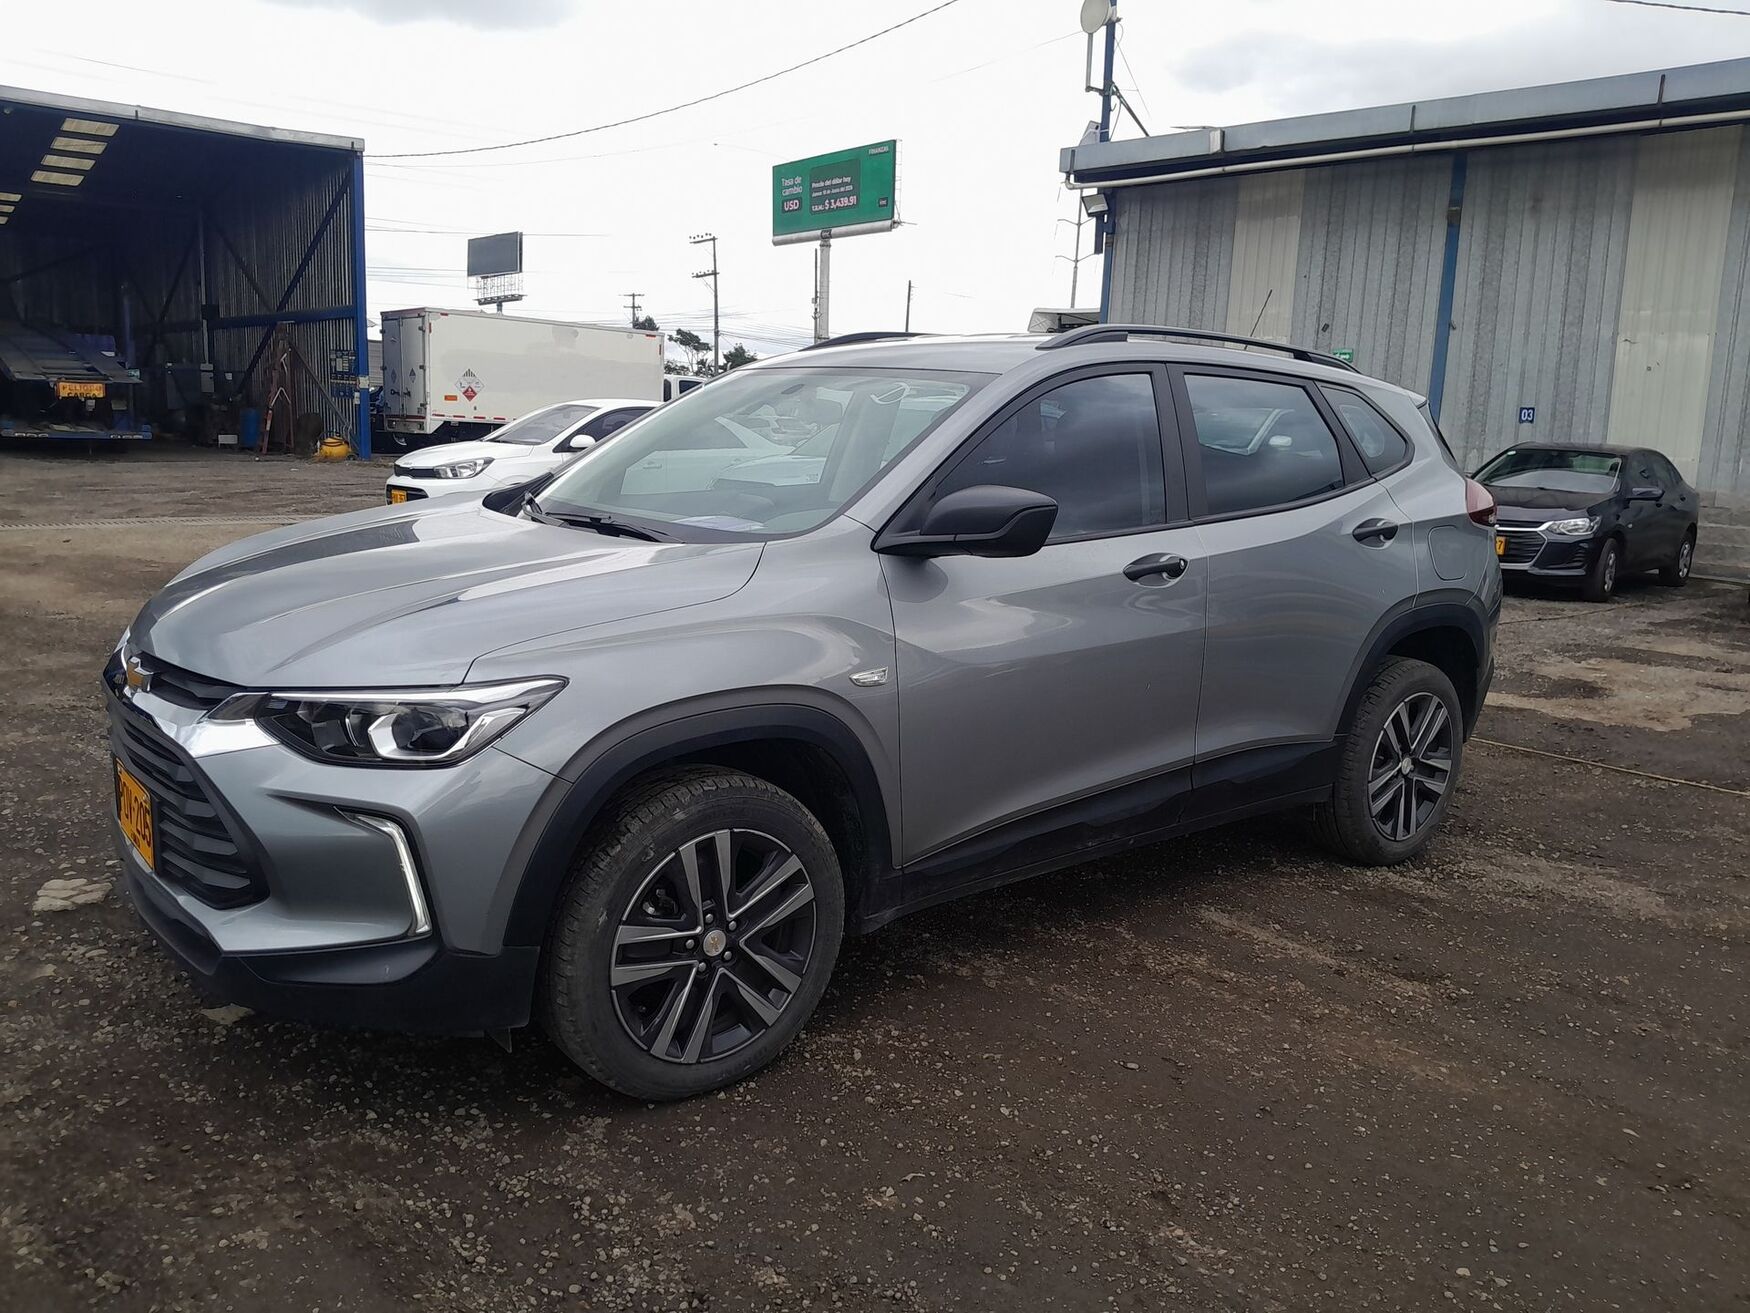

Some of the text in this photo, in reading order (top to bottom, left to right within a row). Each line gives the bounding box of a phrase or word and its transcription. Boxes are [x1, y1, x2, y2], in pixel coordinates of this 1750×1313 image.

[794, 175, 802, 184] de
[781, 185, 803, 196] cambio
[783, 199, 800, 211] USD
[1521, 409, 1534, 421] 03
